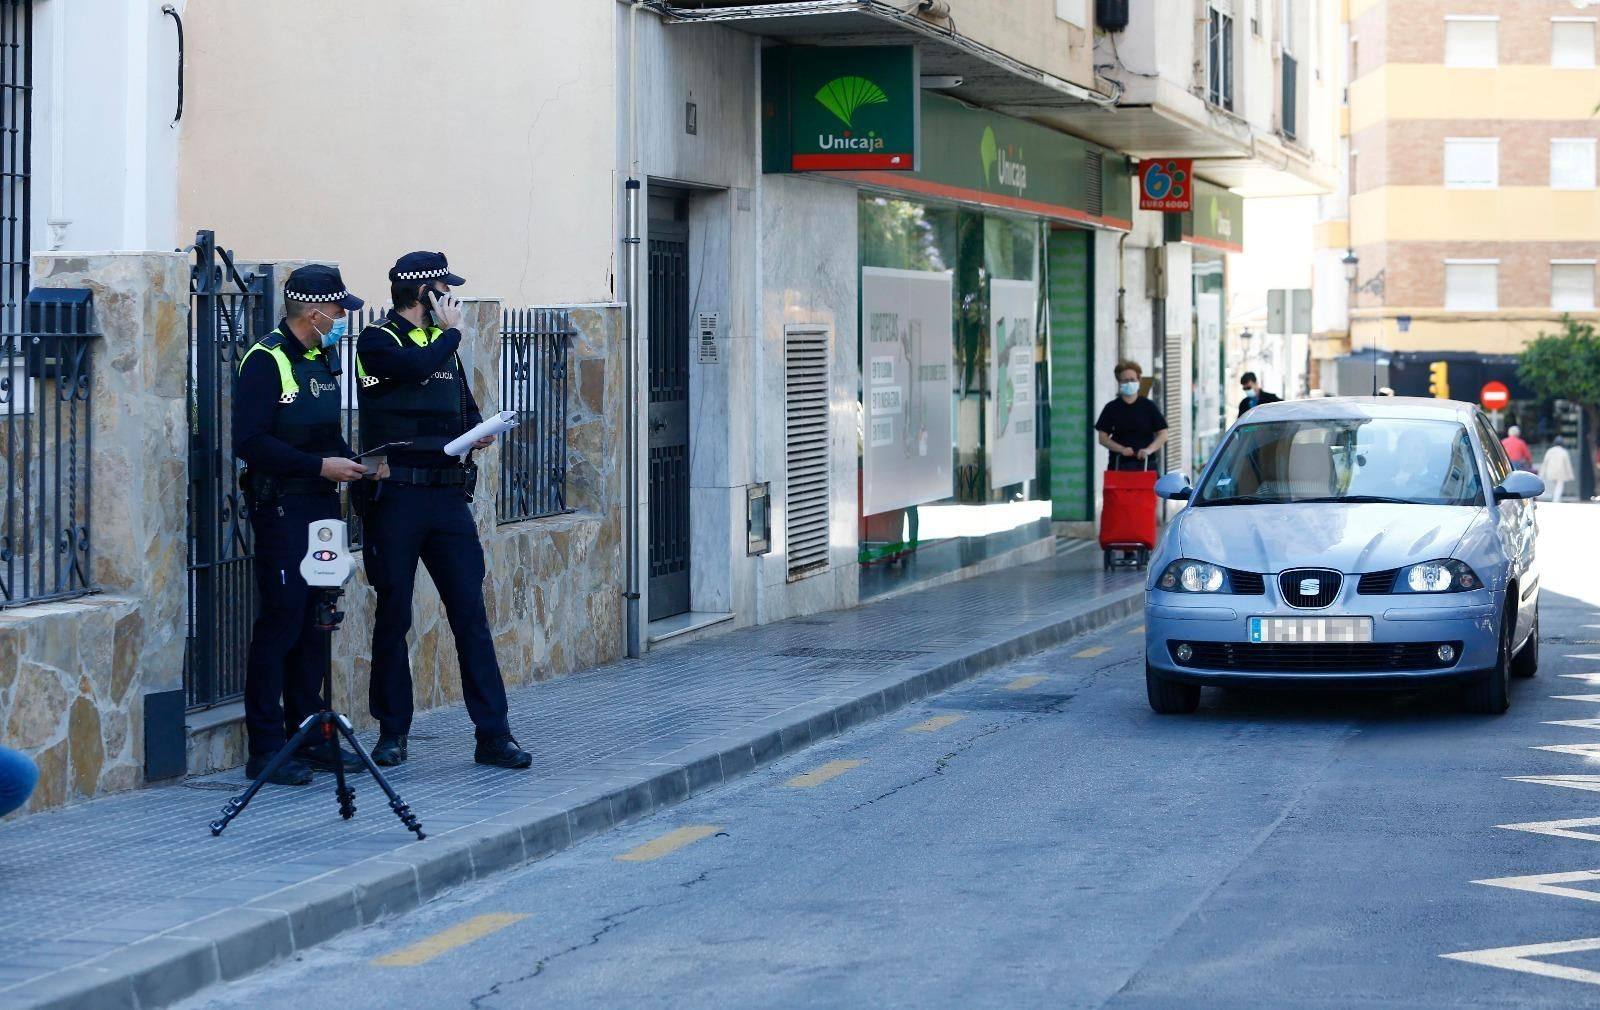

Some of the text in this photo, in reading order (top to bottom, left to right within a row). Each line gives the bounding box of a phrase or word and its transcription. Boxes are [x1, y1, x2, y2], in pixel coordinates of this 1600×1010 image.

[819, 131, 884, 153] Unicaja
[998, 144, 1027, 197] Unicaja
[1141, 200, 1189, 210] EURO 6000
